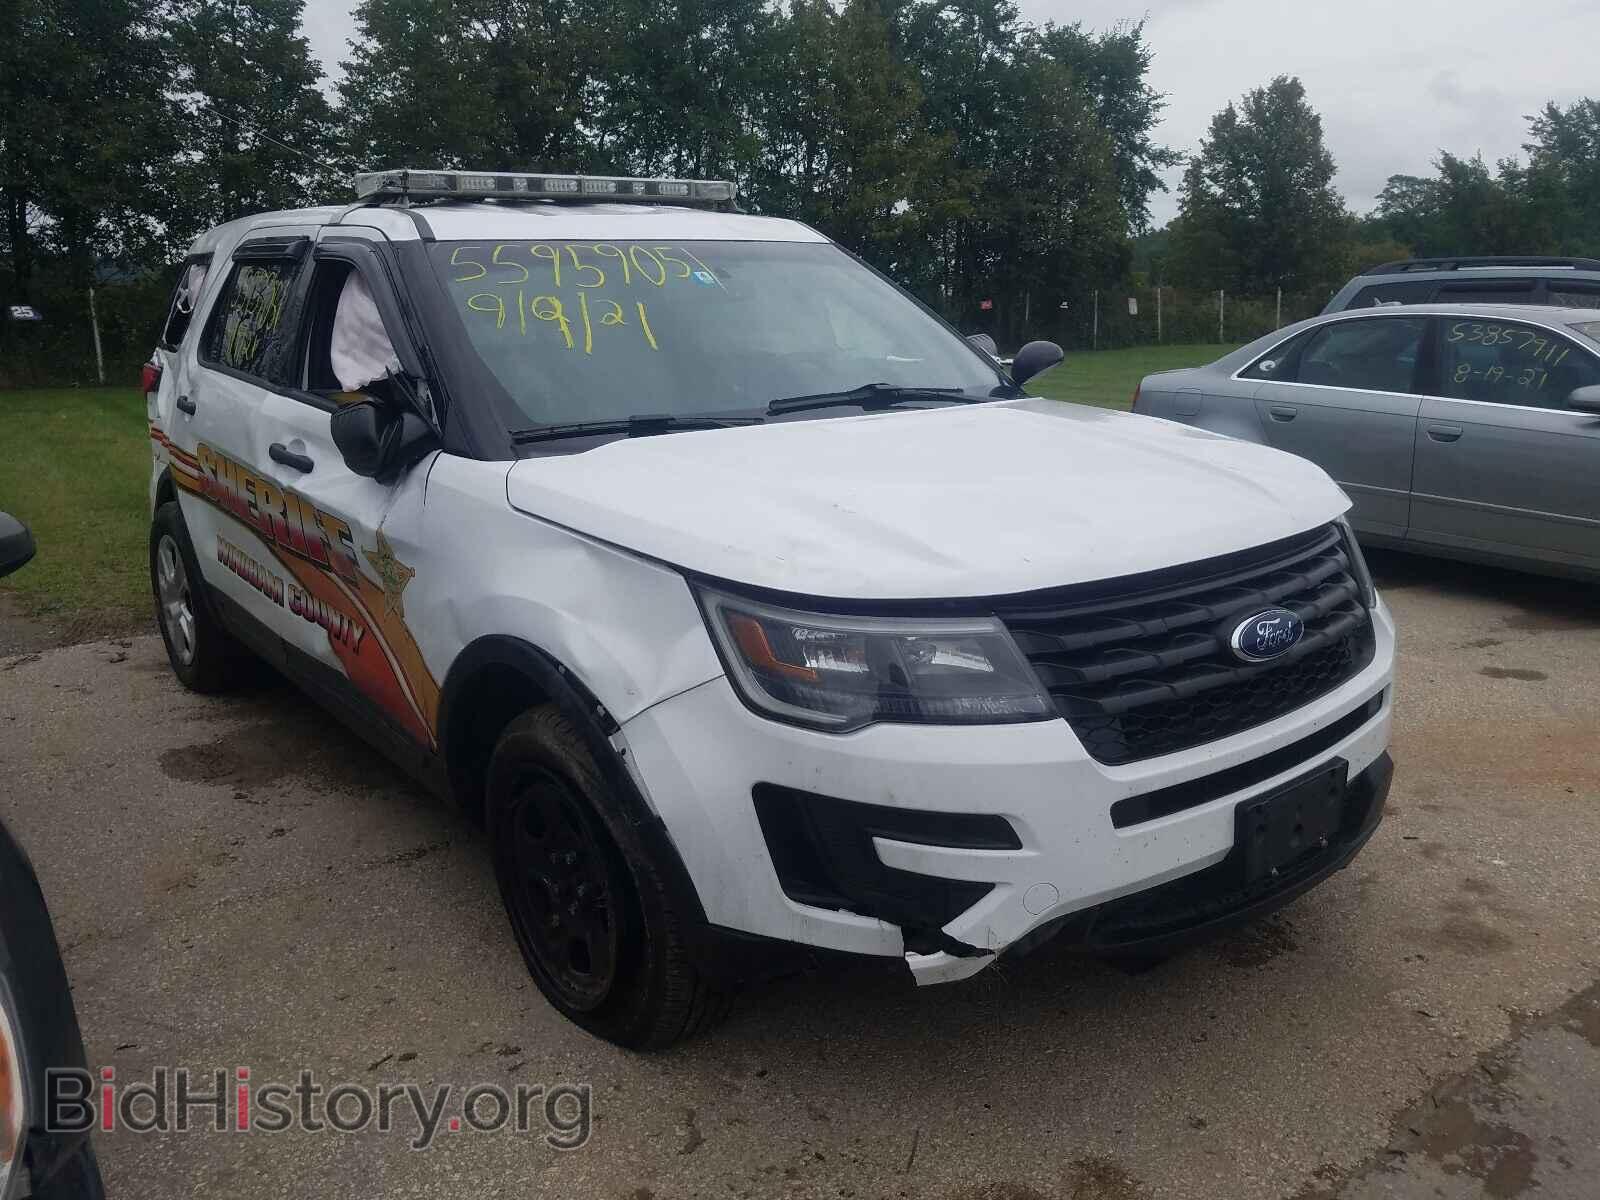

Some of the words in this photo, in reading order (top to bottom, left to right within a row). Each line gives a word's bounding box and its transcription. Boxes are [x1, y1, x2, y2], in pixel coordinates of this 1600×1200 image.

[450, 244, 729, 293] 55959051
[1447, 322, 1570, 367] 53857911
[287, 583, 365, 655] COUNTY
